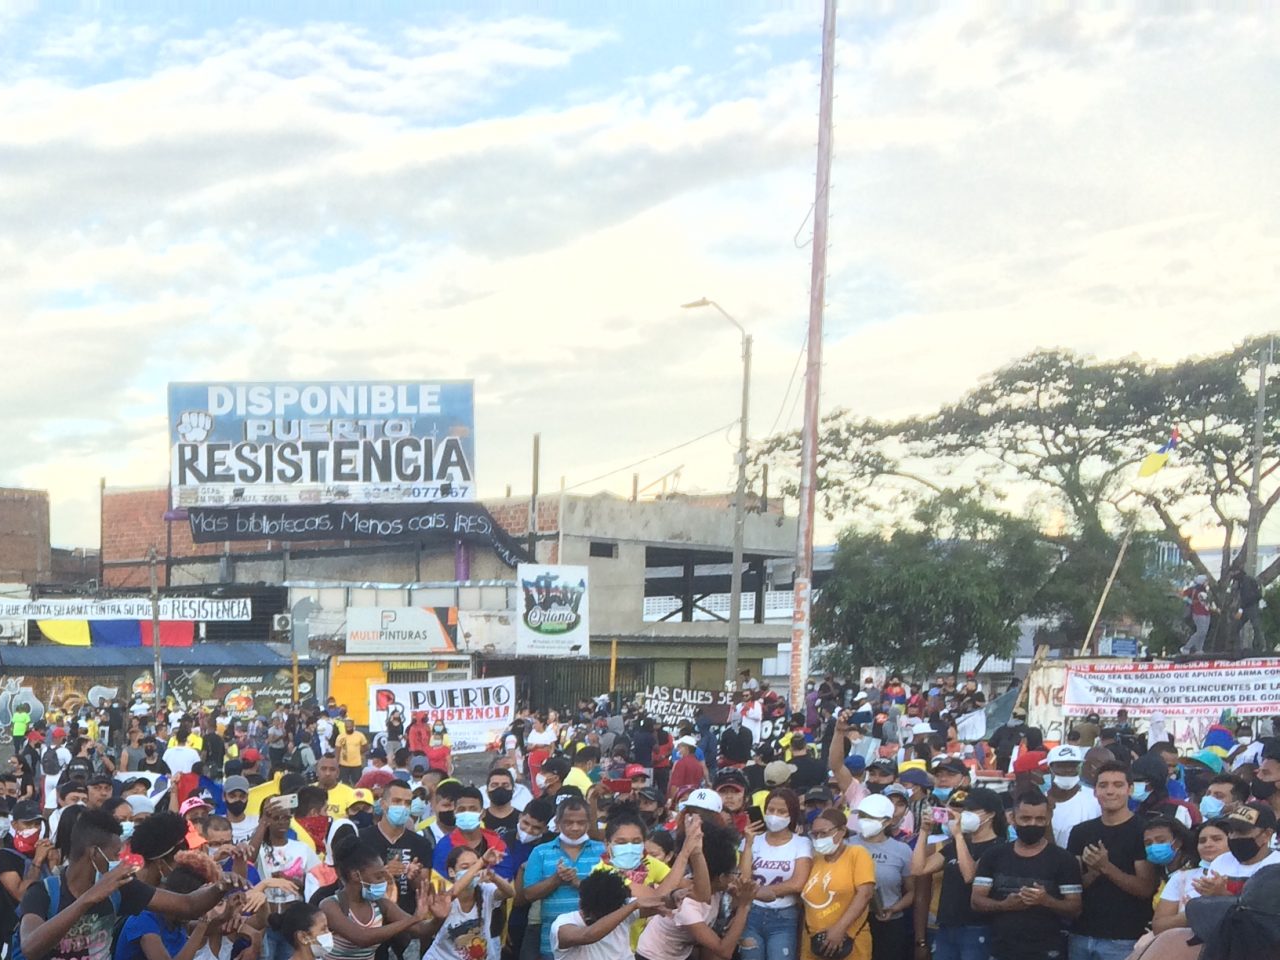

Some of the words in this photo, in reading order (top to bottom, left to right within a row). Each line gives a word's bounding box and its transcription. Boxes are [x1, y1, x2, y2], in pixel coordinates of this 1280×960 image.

[208, 385, 441, 416] DISPONIBLE
[245, 418, 413, 442] PUERTO
[178, 437, 471, 485] RESISTENCIA
[190, 513, 229, 535] Más
[340, 511, 403, 535] Menos
[22, 605, 52, 616] APUNTA
[65, 605, 88, 616] ARMA
[123, 603, 134, 616] SU
[136, 604, 168, 616] PUELO
[171, 599, 250, 619] RESISTENCIA
[529, 605, 576, 627] Oriana
[350, 630, 428, 641] MULTIPINTURAS
[1134, 672, 1172, 680] SOLDADO
[1173, 671, 1189, 680] QUE
[1191, 670, 1223, 678] APUNTA
[1237, 669, 1262, 677] ARMA
[409, 685, 510, 709] PUERTO
[645, 685, 670, 700] LAS
[672, 688, 713, 704] CALLES
[717, 692, 734, 705] SE
[1157, 686, 1176, 694] LOS
[1179, 684, 1251, 693] DELINCUENTES
[1254, 683, 1268, 691] DE
[1095, 696, 1140, 704] PRIMERO
[1141, 696, 1160, 704] HAY
[1162, 696, 1182, 704] QUE
[1184, 695, 1236, 704] SACARLOS
[1239, 694, 1258, 702] DEL
[410, 706, 510, 722] ESISTENCIA
